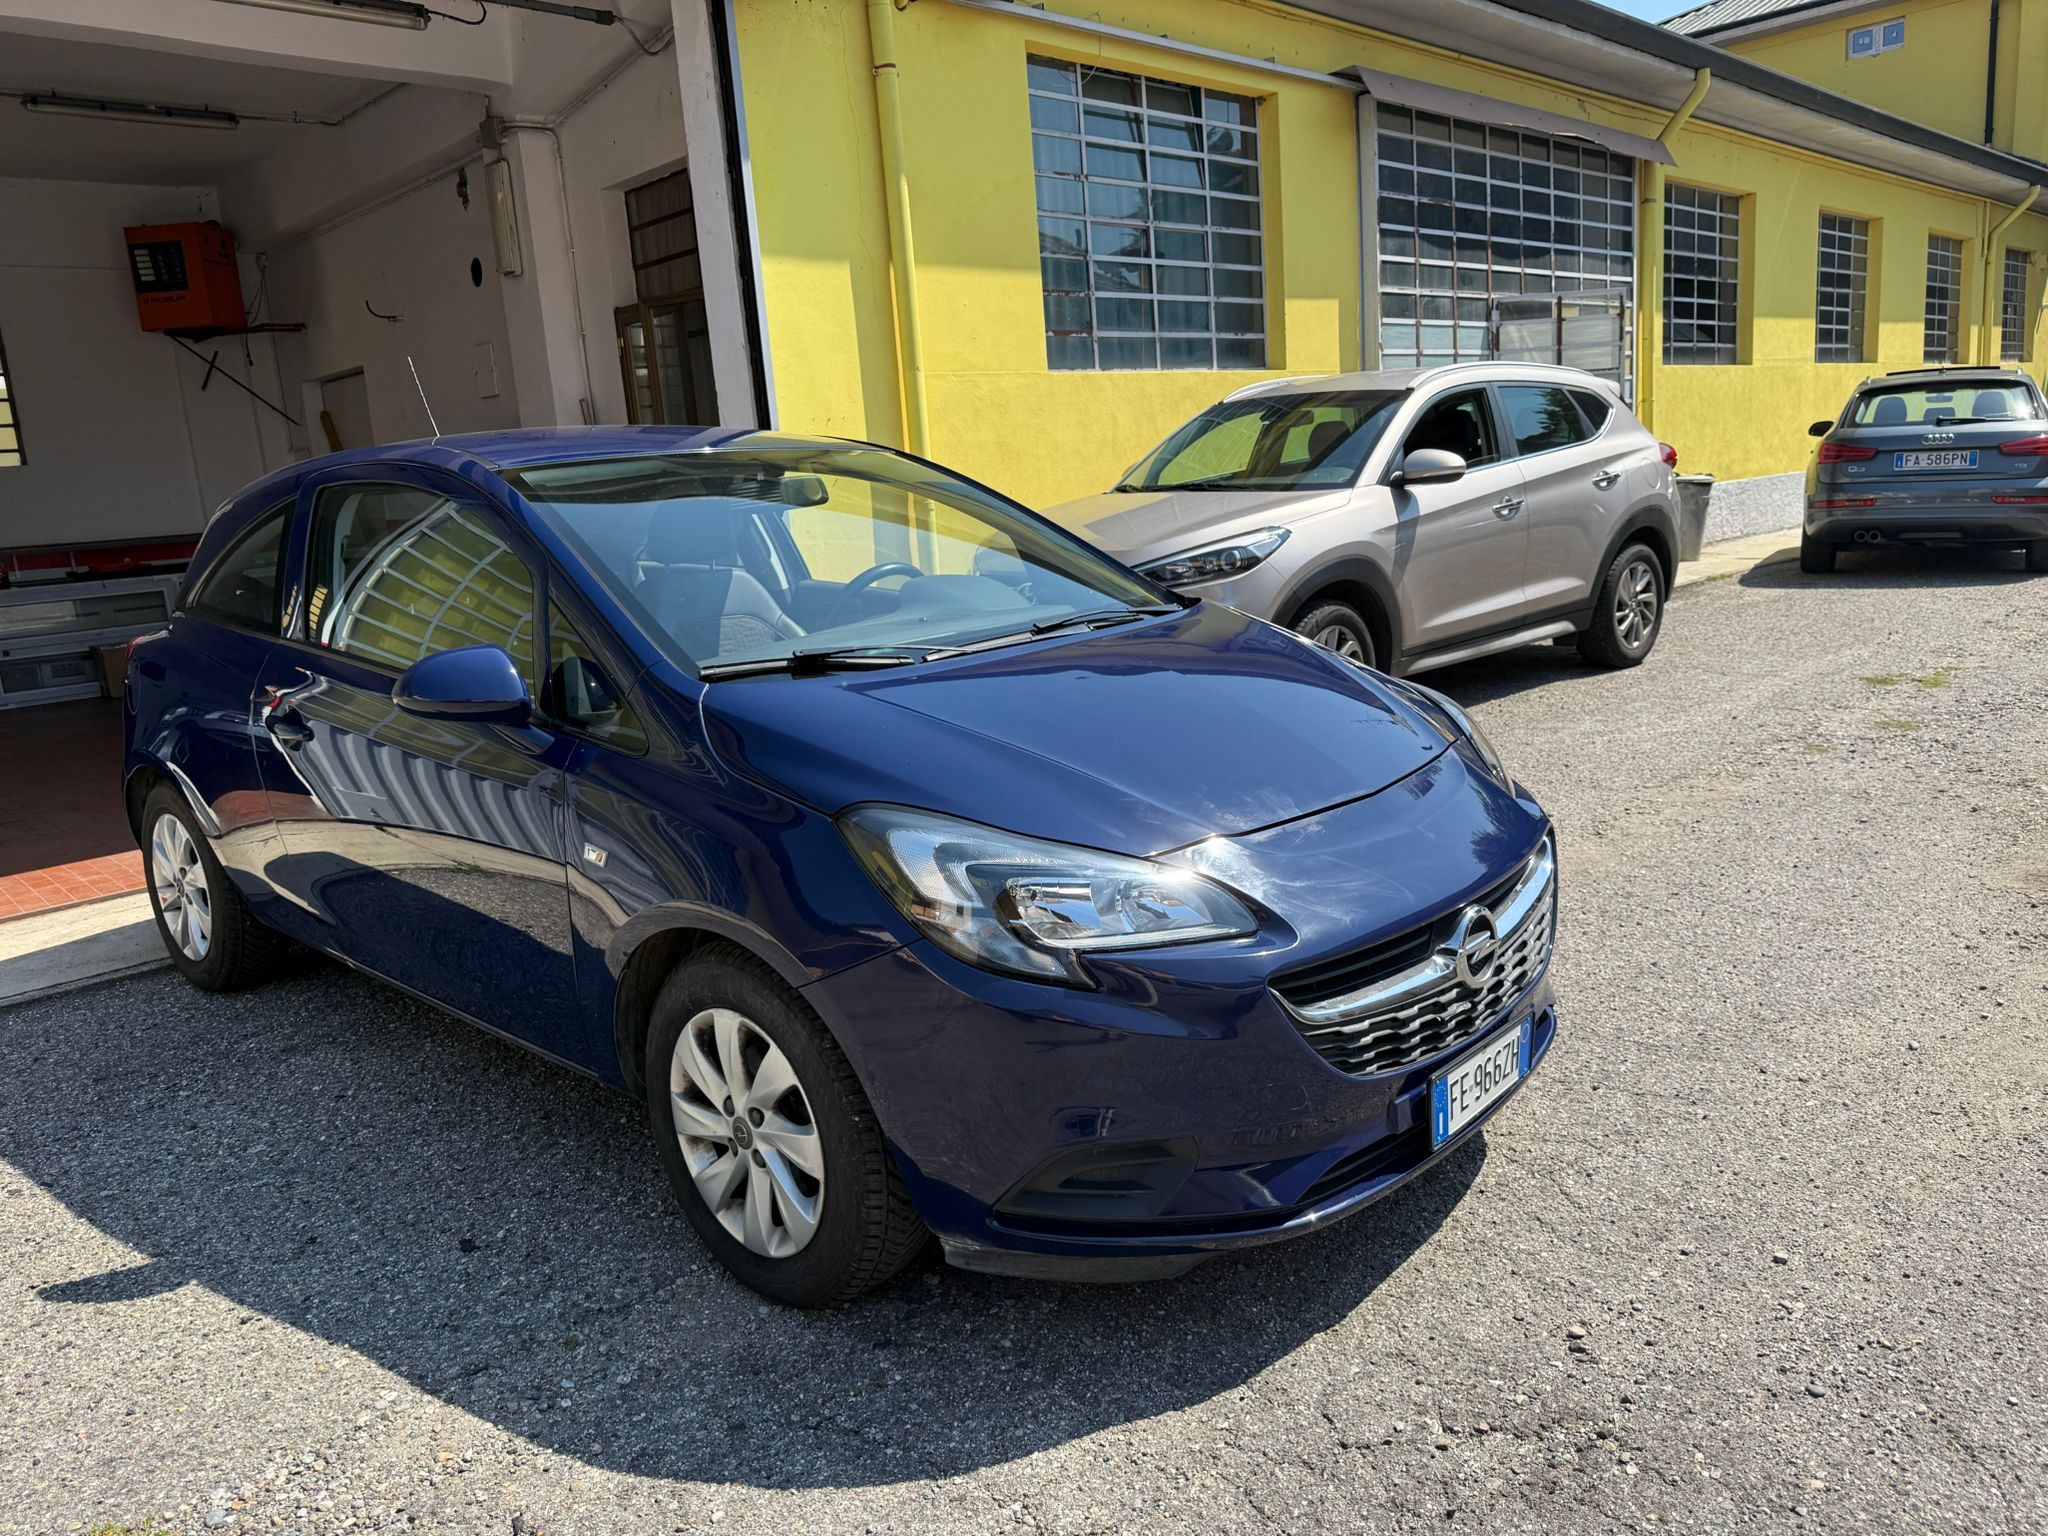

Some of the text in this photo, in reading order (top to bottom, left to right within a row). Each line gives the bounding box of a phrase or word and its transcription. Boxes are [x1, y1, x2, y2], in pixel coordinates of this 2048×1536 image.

[1904, 454, 1921, 467] FA
[1926, 453, 1968, 466] 586PN
[1449, 1071, 1470, 1122] FE
[1474, 1035, 1520, 1101] 966ZH
